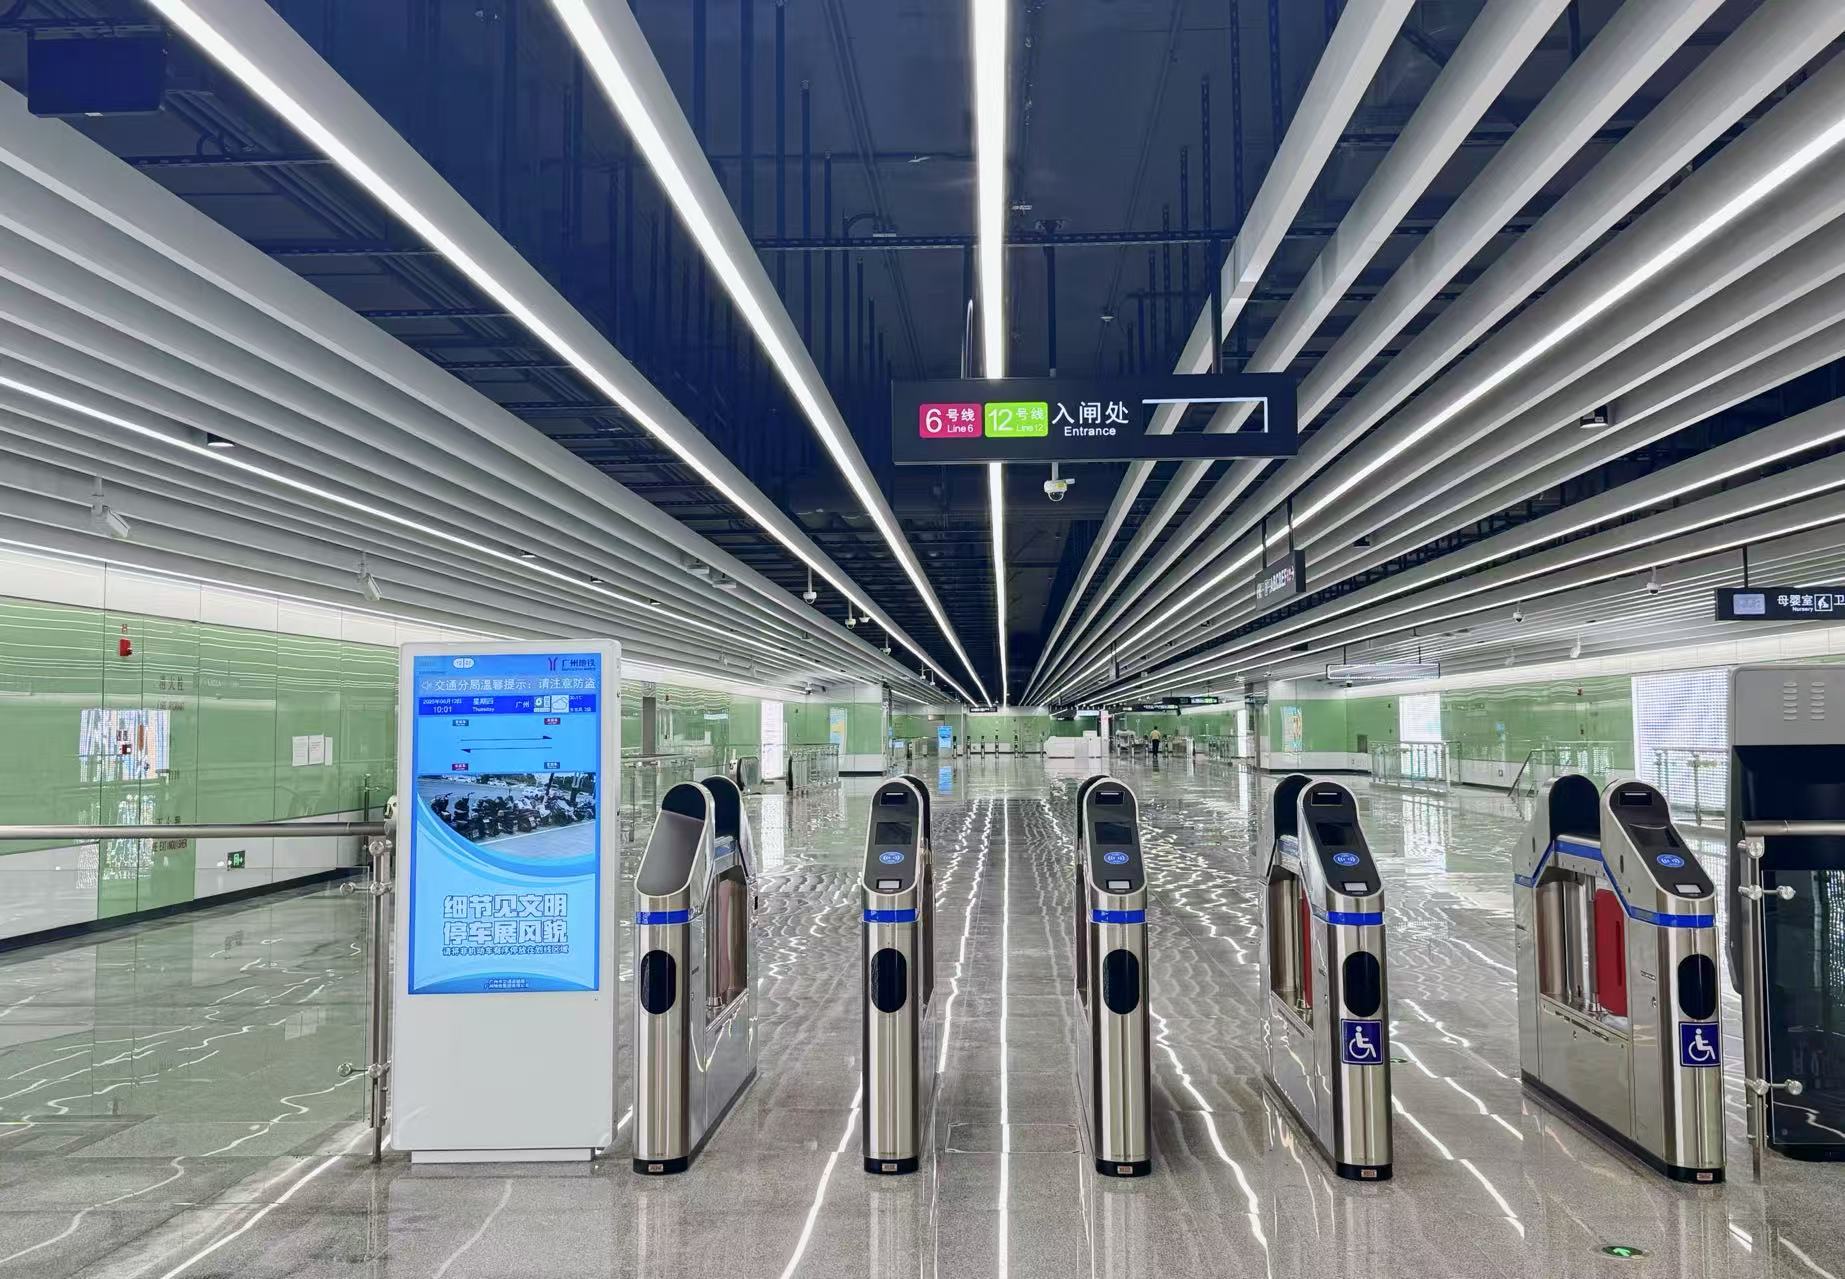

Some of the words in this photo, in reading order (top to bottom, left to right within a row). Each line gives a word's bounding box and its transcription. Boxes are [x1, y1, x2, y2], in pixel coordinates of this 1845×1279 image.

[1051, 400, 1130, 425] 入闸处
[947, 423, 967, 433] Line
[968, 423, 974, 433] 6
[1034, 423, 1044, 433] 12
[1064, 425, 1117, 437] Entrance
[1777, 594, 1814, 606] 母婴室
[472, 697, 494, 705] 星期四
[443, 894, 568, 918] 细节见文明
[443, 920, 568, 945] 停车展风貌
